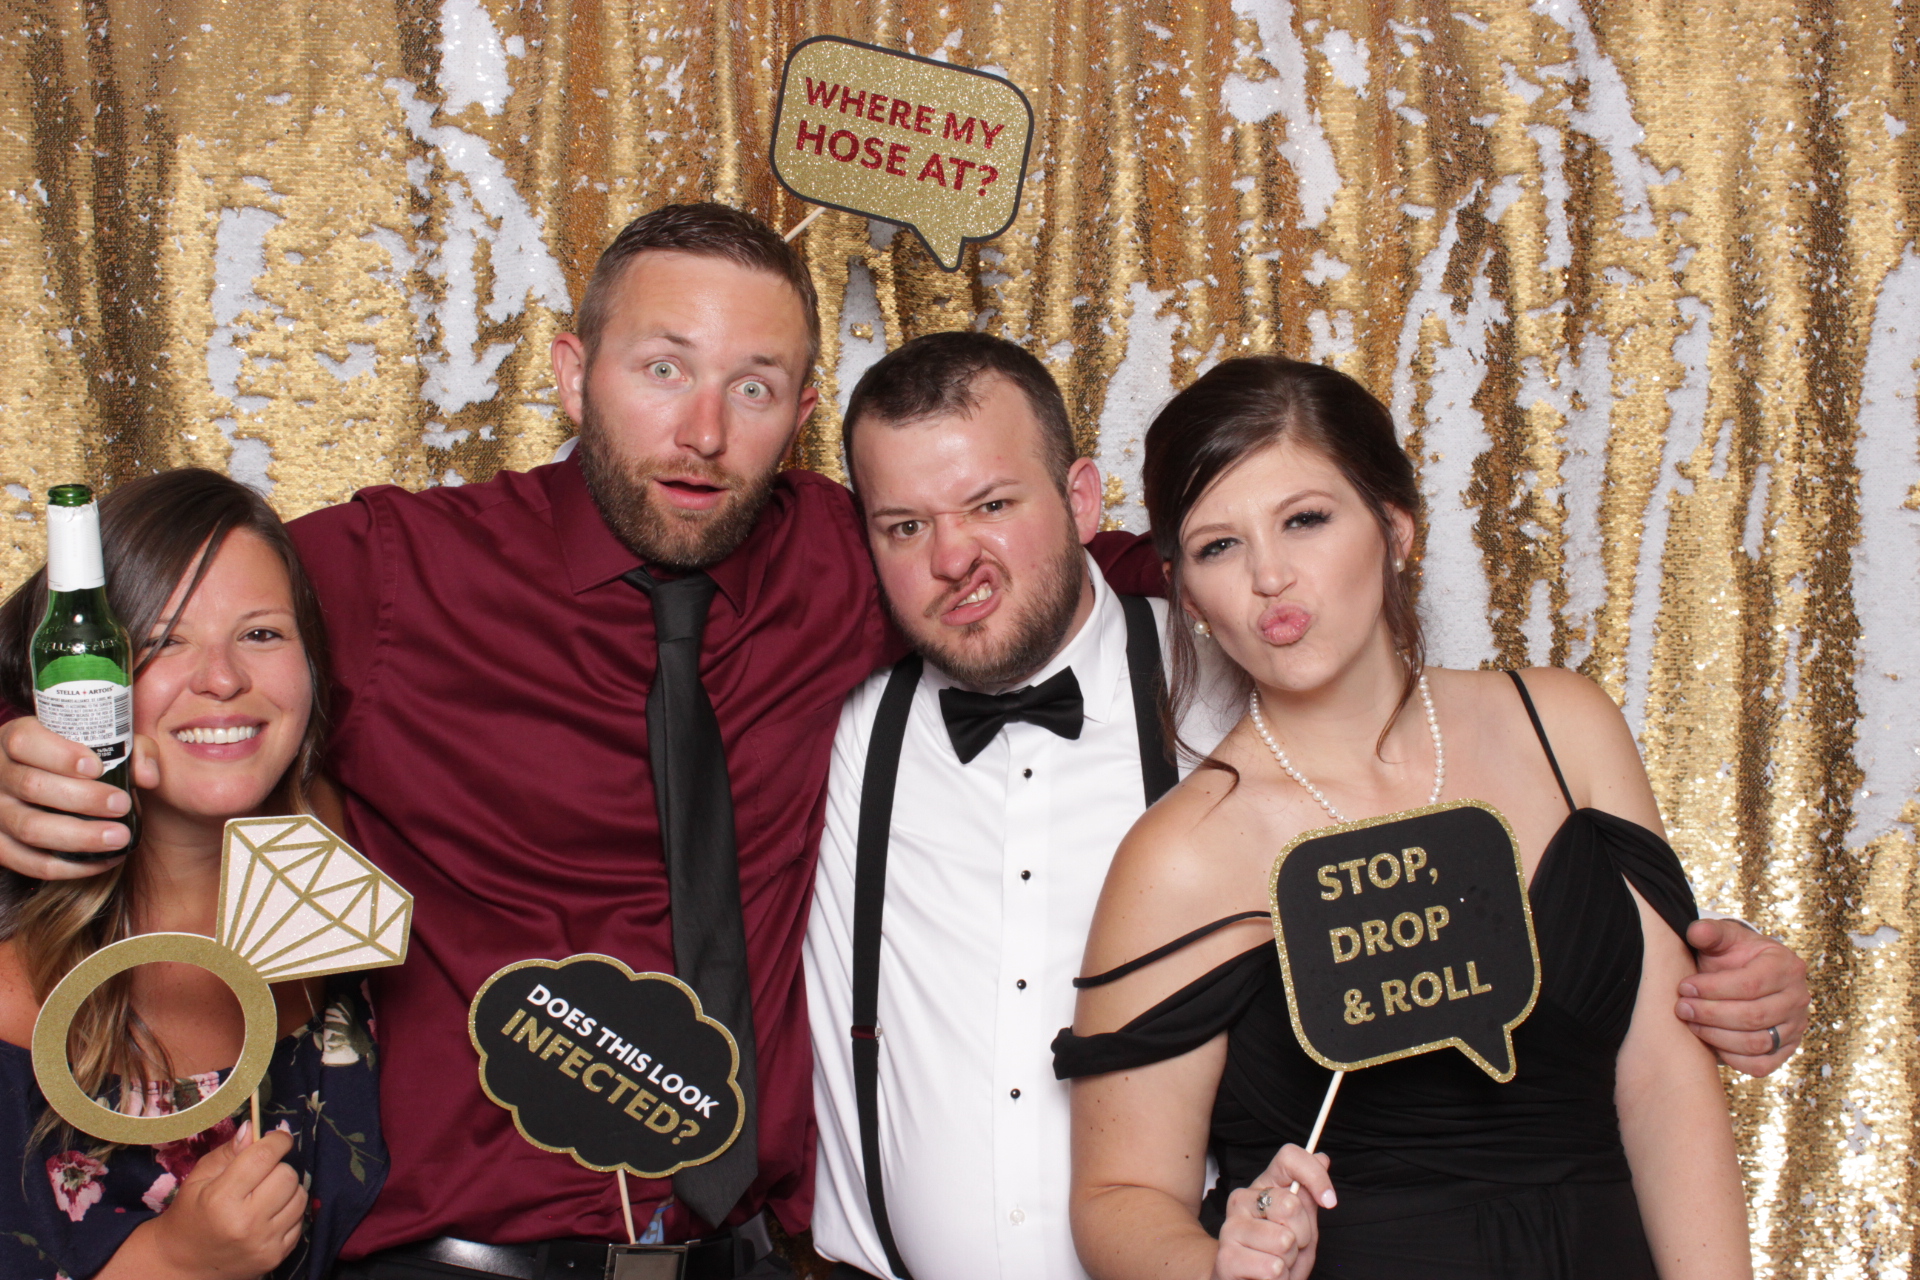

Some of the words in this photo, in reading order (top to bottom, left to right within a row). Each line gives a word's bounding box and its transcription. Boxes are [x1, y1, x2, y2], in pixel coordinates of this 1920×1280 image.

[805, 77, 936, 135] WHERE
[942, 111, 1005, 150] MY
[795, 119, 911, 178] HOSE
[916, 153, 999, 197] AT?
[88, 687, 113, 695] ARTOIS
[1317, 846, 1438, 901] STOP,
[1328, 904, 1450, 964] DROP
[1343, 988, 1376, 1025] &
[1380, 960, 1493, 1016] ROLL
[501, 1008, 701, 1145] INFECTED?
[526, 983, 597, 1037] DOES
[595, 1027, 652, 1073] THIS
[647, 1063, 720, 1119] LOOK
